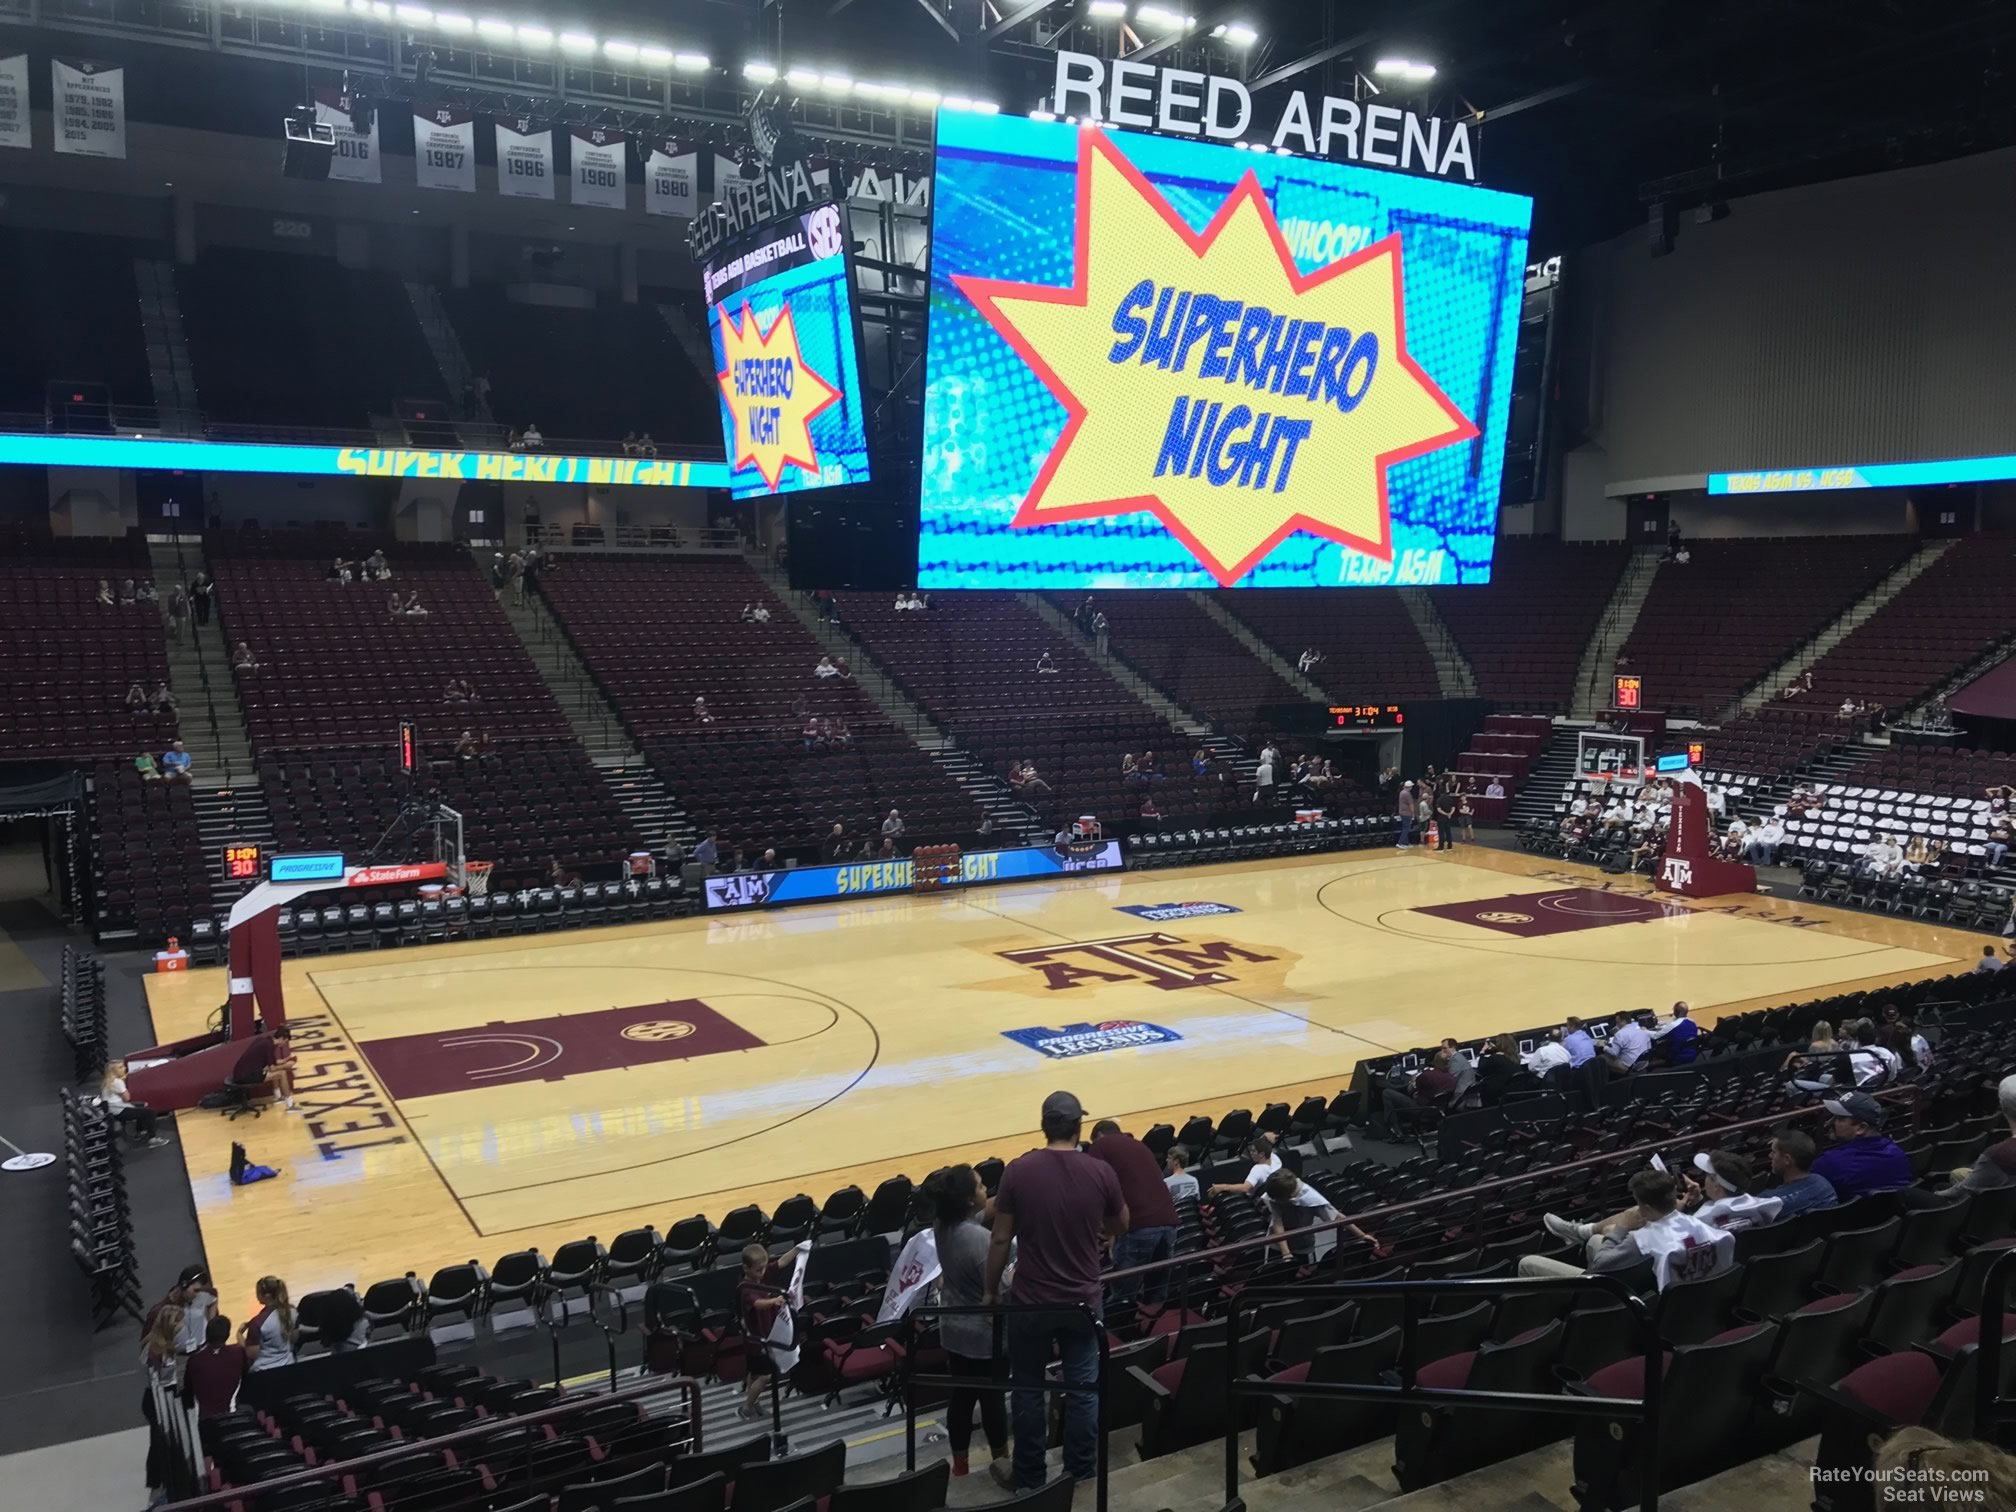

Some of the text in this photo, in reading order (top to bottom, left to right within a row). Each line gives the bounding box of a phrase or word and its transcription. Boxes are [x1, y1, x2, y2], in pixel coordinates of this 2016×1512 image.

[1053, 50, 1476, 181] REED ARENA
[425, 149, 465, 170] 1987
[507, 158, 545, 178] 1986
[580, 167, 617, 188] 1980
[654, 178, 689, 197] 1980
[726, 160, 814, 237] ARENA
[273, 221, 312, 238] 220
[743, 232, 807, 272] BASKETBALL
[1107, 278, 1379, 413] SUPERHERO
[734, 356, 794, 400] SUPERHERO
[749, 405, 781, 446] NIGHT
[1152, 395, 1313, 494] NIGHT
[336, 448, 692, 487] SUPER HERO NIGHT
[1395, 548, 1447, 585] A&M
[1619, 688, 1637, 706] 30
[226, 847, 257, 861] 31:04
[231, 859, 253, 876] 30
[279, 862, 337, 873] PROGRESSIVE
[167, 959, 178, 970] G
[1037, 1024, 1149, 1047] PROGRESSIVE
[1042, 1029, 1165, 1054] LEGENDS
